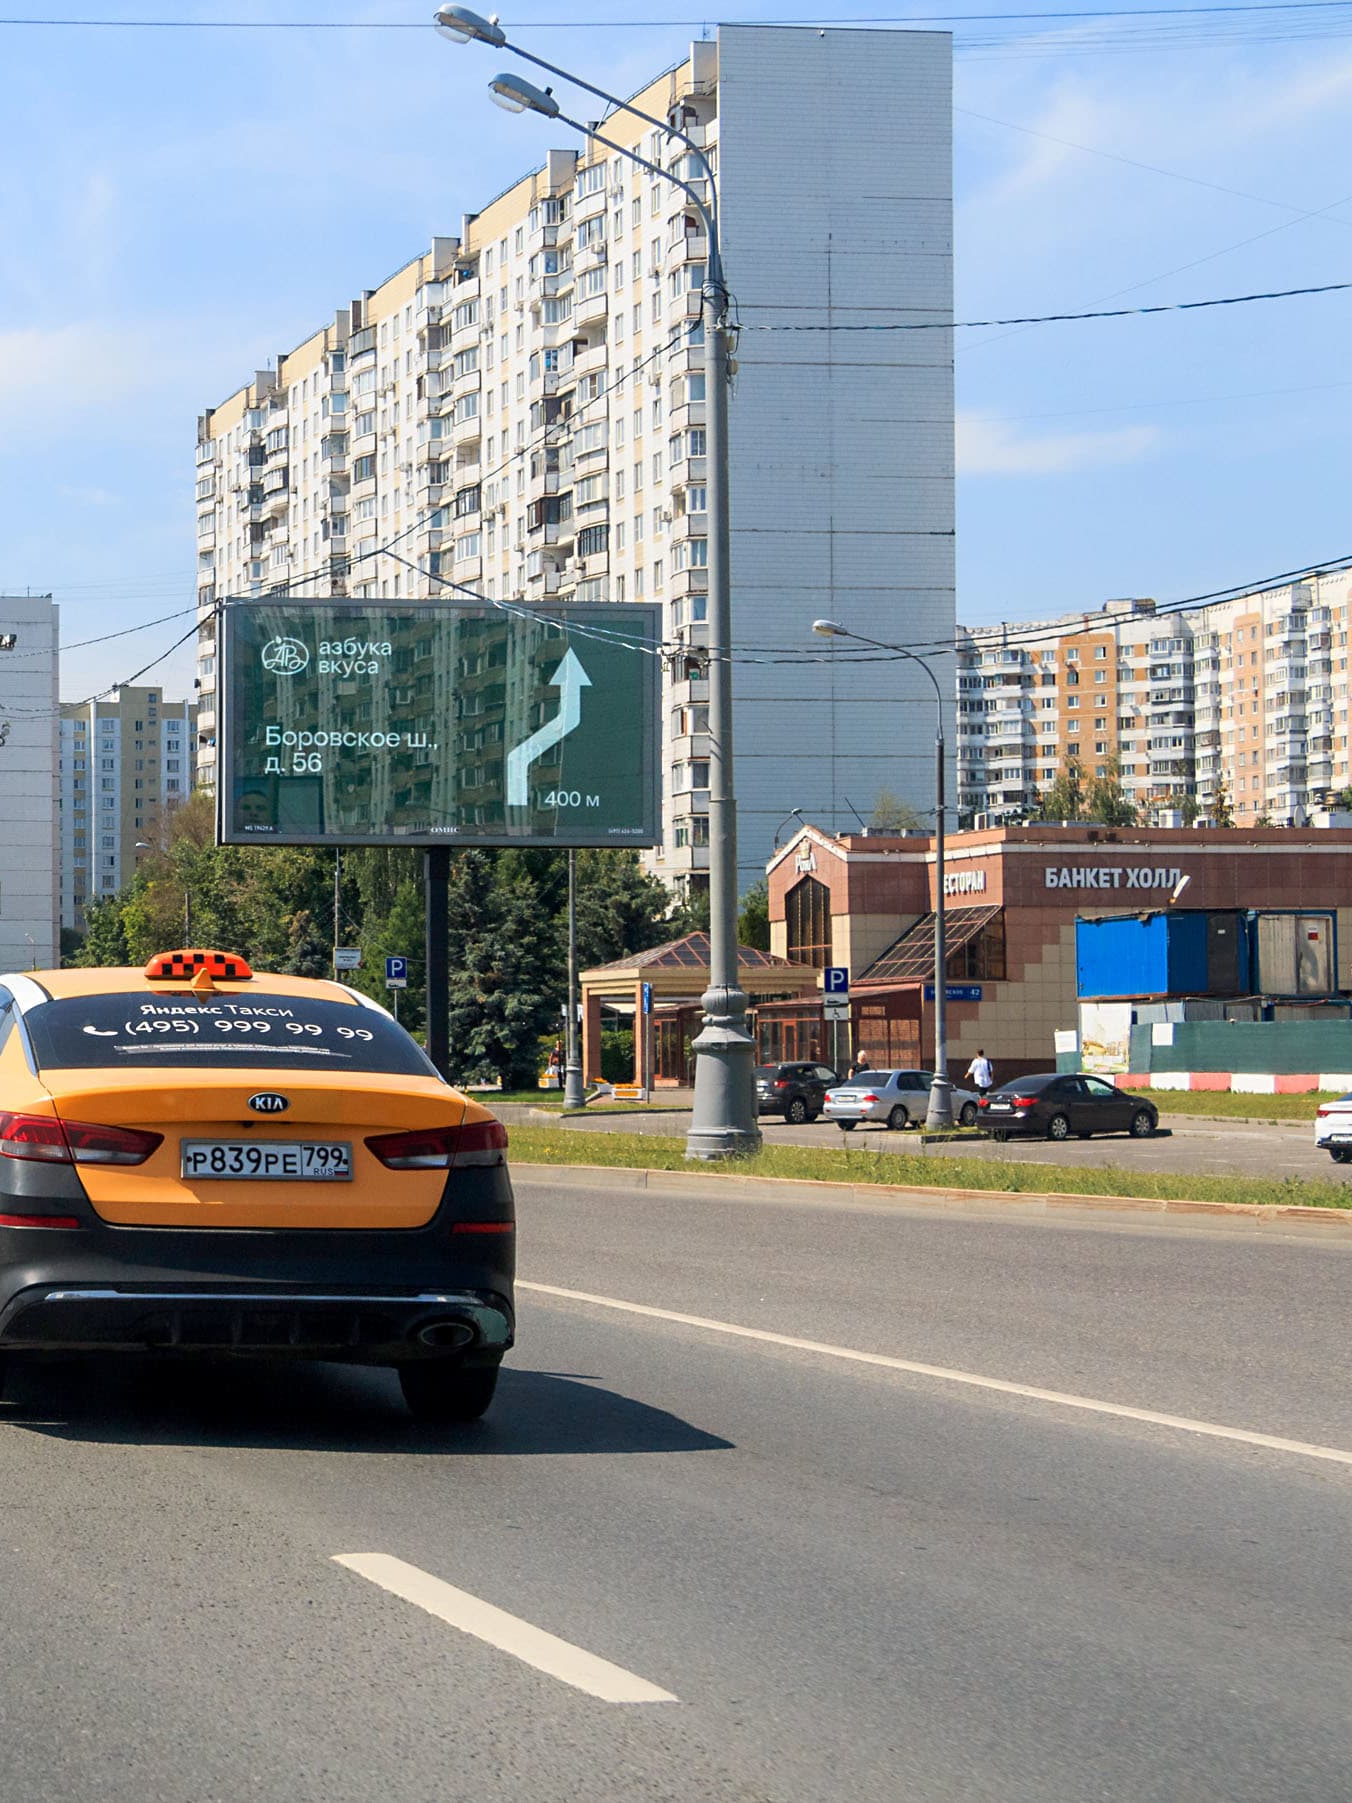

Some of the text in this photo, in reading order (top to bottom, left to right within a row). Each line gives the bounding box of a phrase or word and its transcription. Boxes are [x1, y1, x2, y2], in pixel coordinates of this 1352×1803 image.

[319, 637, 392, 660] азбука
[319, 660, 379, 678] вкуса
[266, 726, 438, 750] Боровское ш.,
[264, 753, 322, 775] д. 56
[544, 791, 581, 807] 400
[943, 870, 985, 894] ЕСТОРАН
[1045, 868, 1181, 889] БАНКЕТ ХОЛЛ
[391, 960, 403, 976] P
[830, 970, 844, 991] P
[140, 1004, 294, 1017] Яндекс Такси
[125, 1019, 374, 1041] (495) 999 99 99
[255, 1097, 284, 1110] KIA
[303, 1146, 343, 1167] 799
[313, 1168, 334, 1176] RUS
